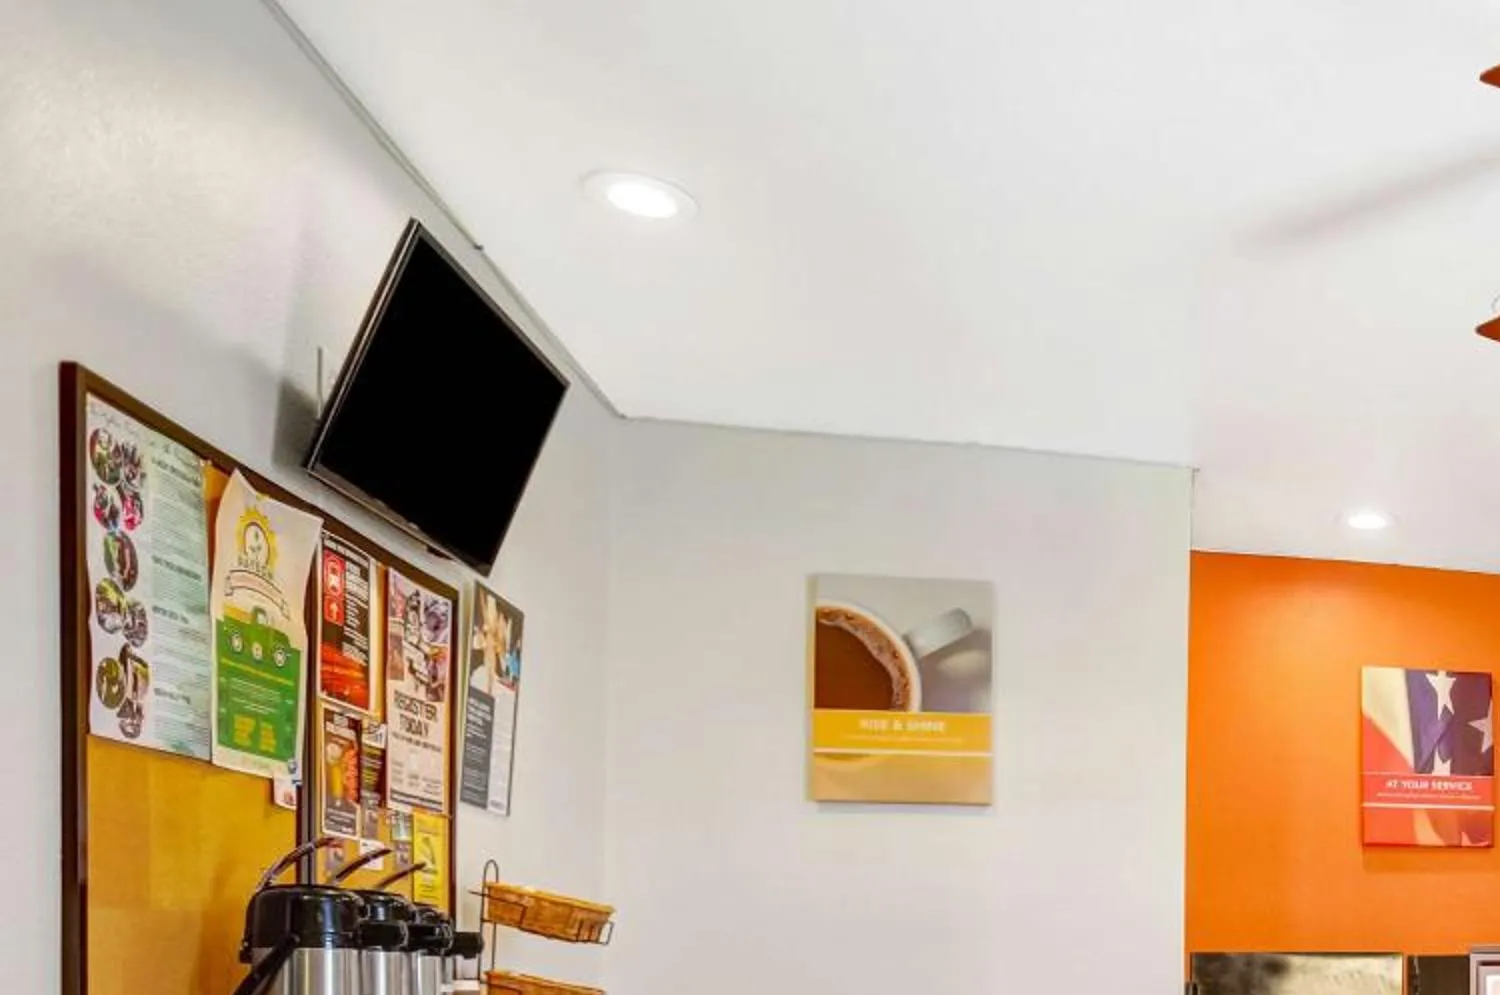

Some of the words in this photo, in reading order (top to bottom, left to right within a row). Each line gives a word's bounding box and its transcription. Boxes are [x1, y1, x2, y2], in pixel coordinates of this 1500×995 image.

[1386, 780, 1399, 789] AT
[1401, 780, 1429, 790] YOUR
[1431, 780, 1473, 791] SERVICE
